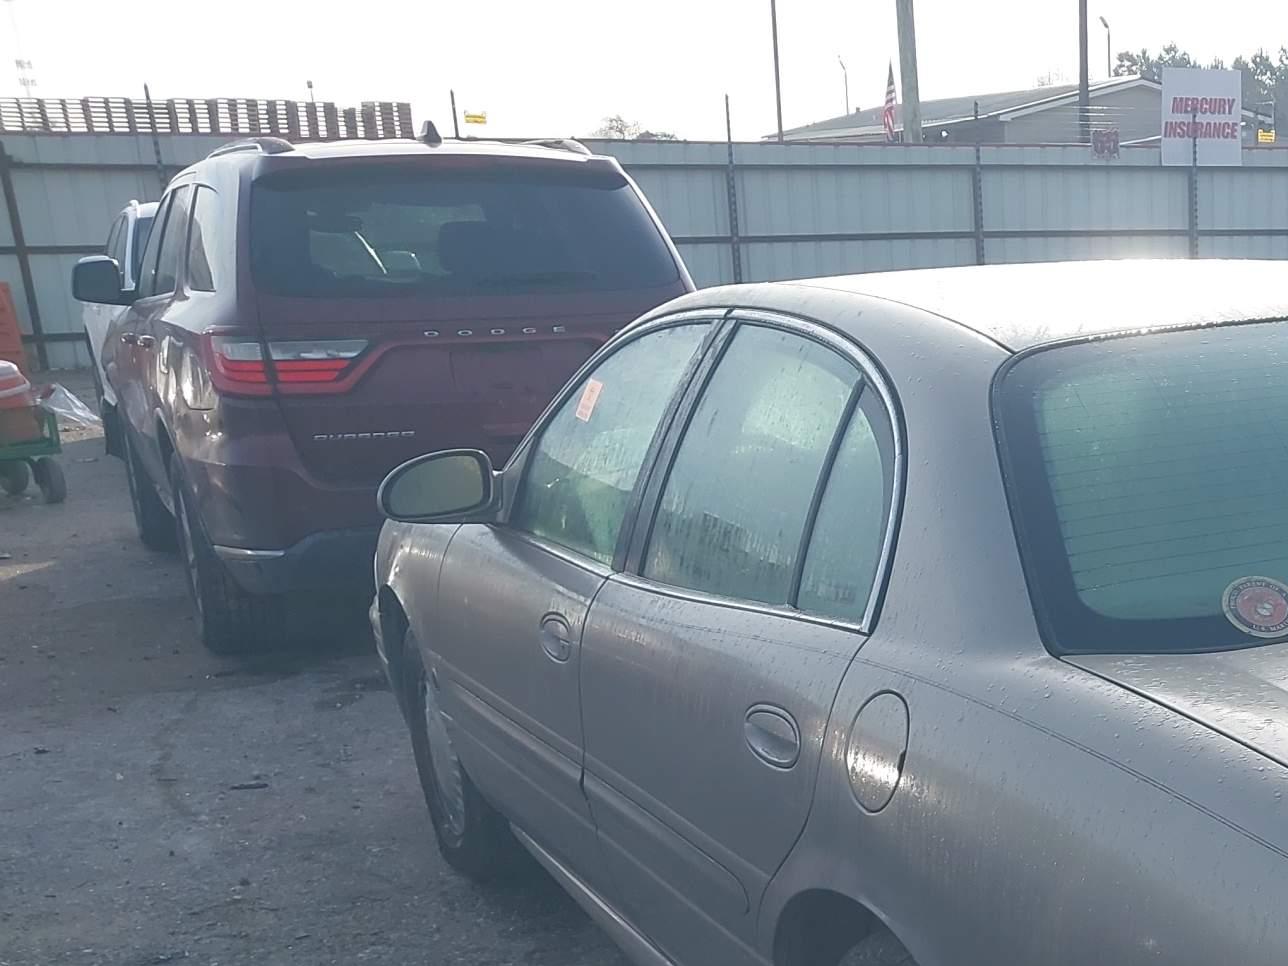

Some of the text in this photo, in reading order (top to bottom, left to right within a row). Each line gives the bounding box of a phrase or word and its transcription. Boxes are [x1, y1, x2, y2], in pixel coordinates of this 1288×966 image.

[1172, 97, 1236, 115] MERCURY
[1164, 121, 1238, 139] INSURANCE
[424, 326, 565, 337] DODGE
